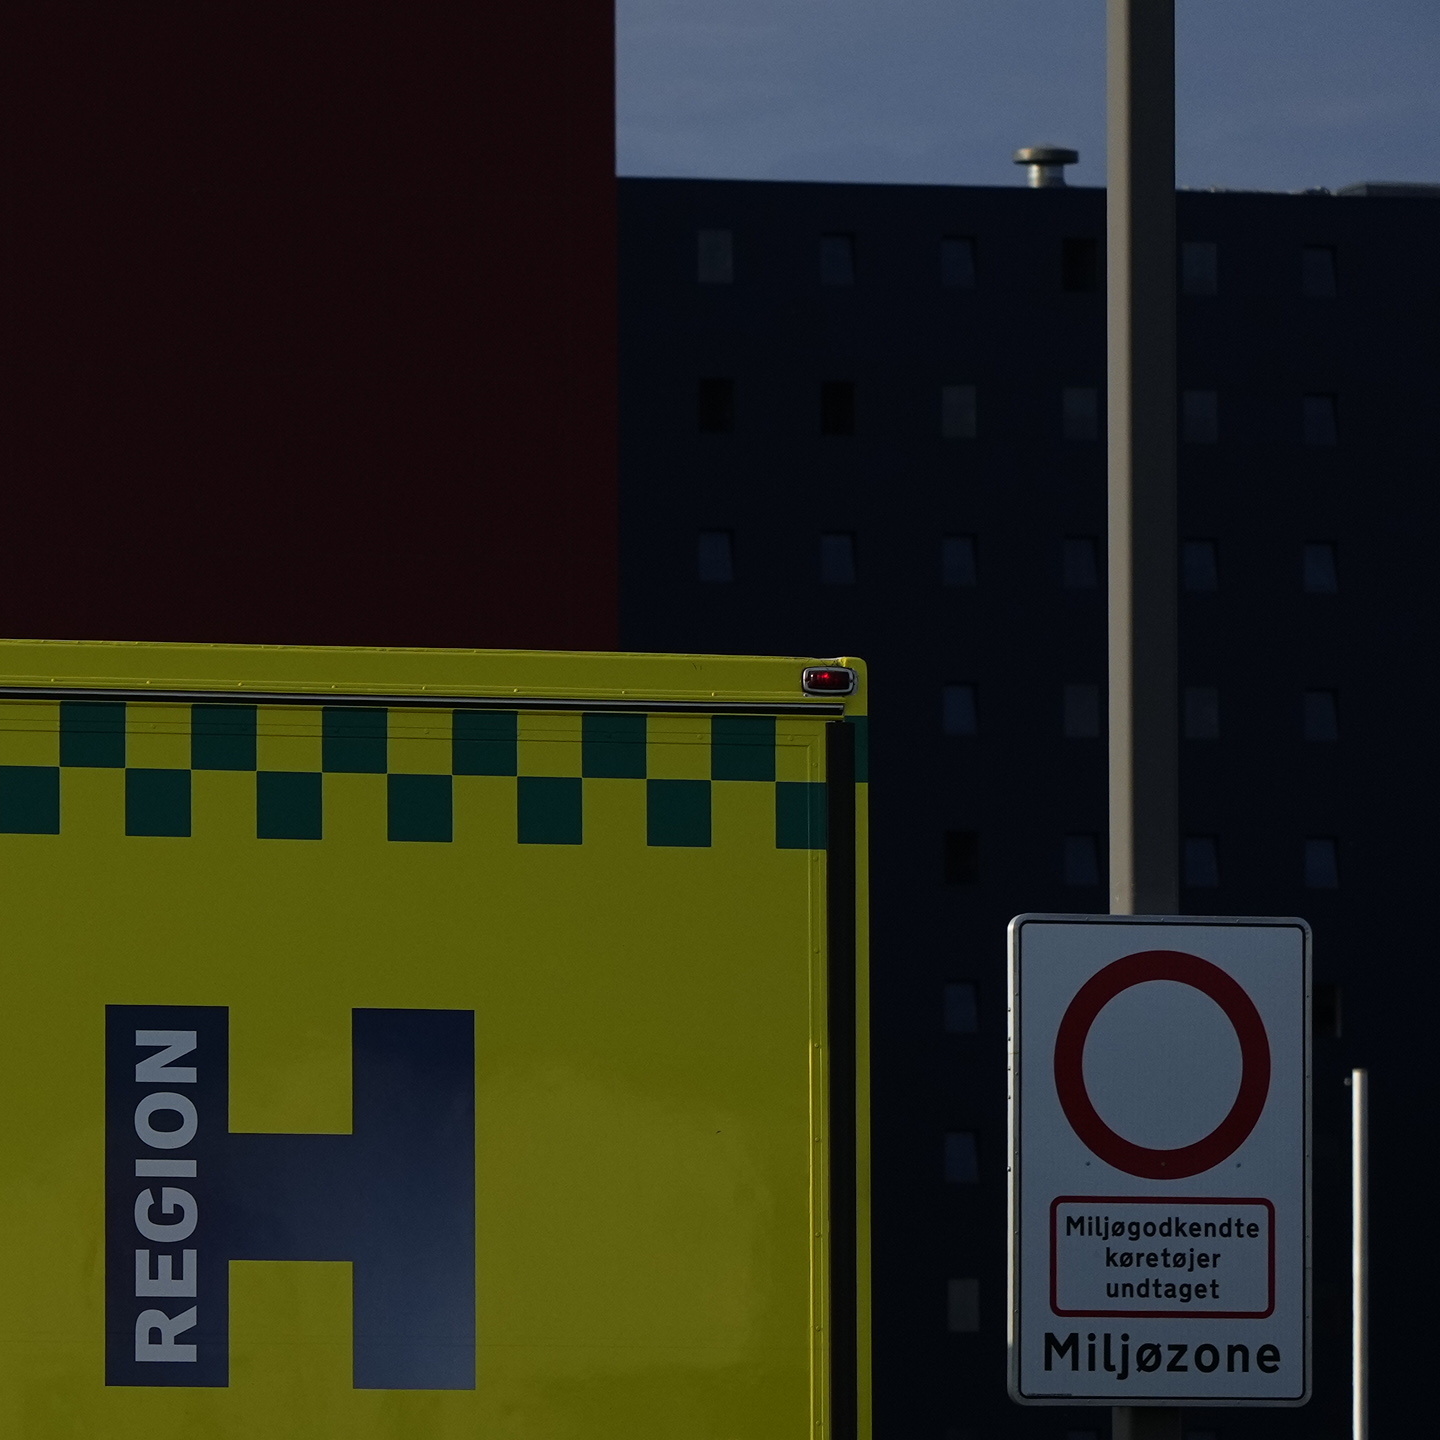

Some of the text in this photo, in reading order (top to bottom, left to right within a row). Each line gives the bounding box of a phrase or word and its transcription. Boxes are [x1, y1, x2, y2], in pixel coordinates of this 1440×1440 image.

[134, 1029, 198, 1364] REGION
[1066, 1215, 1260, 1242] Miljøgodkendte
[1105, 1246, 1222, 1272] køretøjer
[1105, 1278, 1220, 1304] undtaget
[1043, 1332, 1281, 1380] Miljøzone
